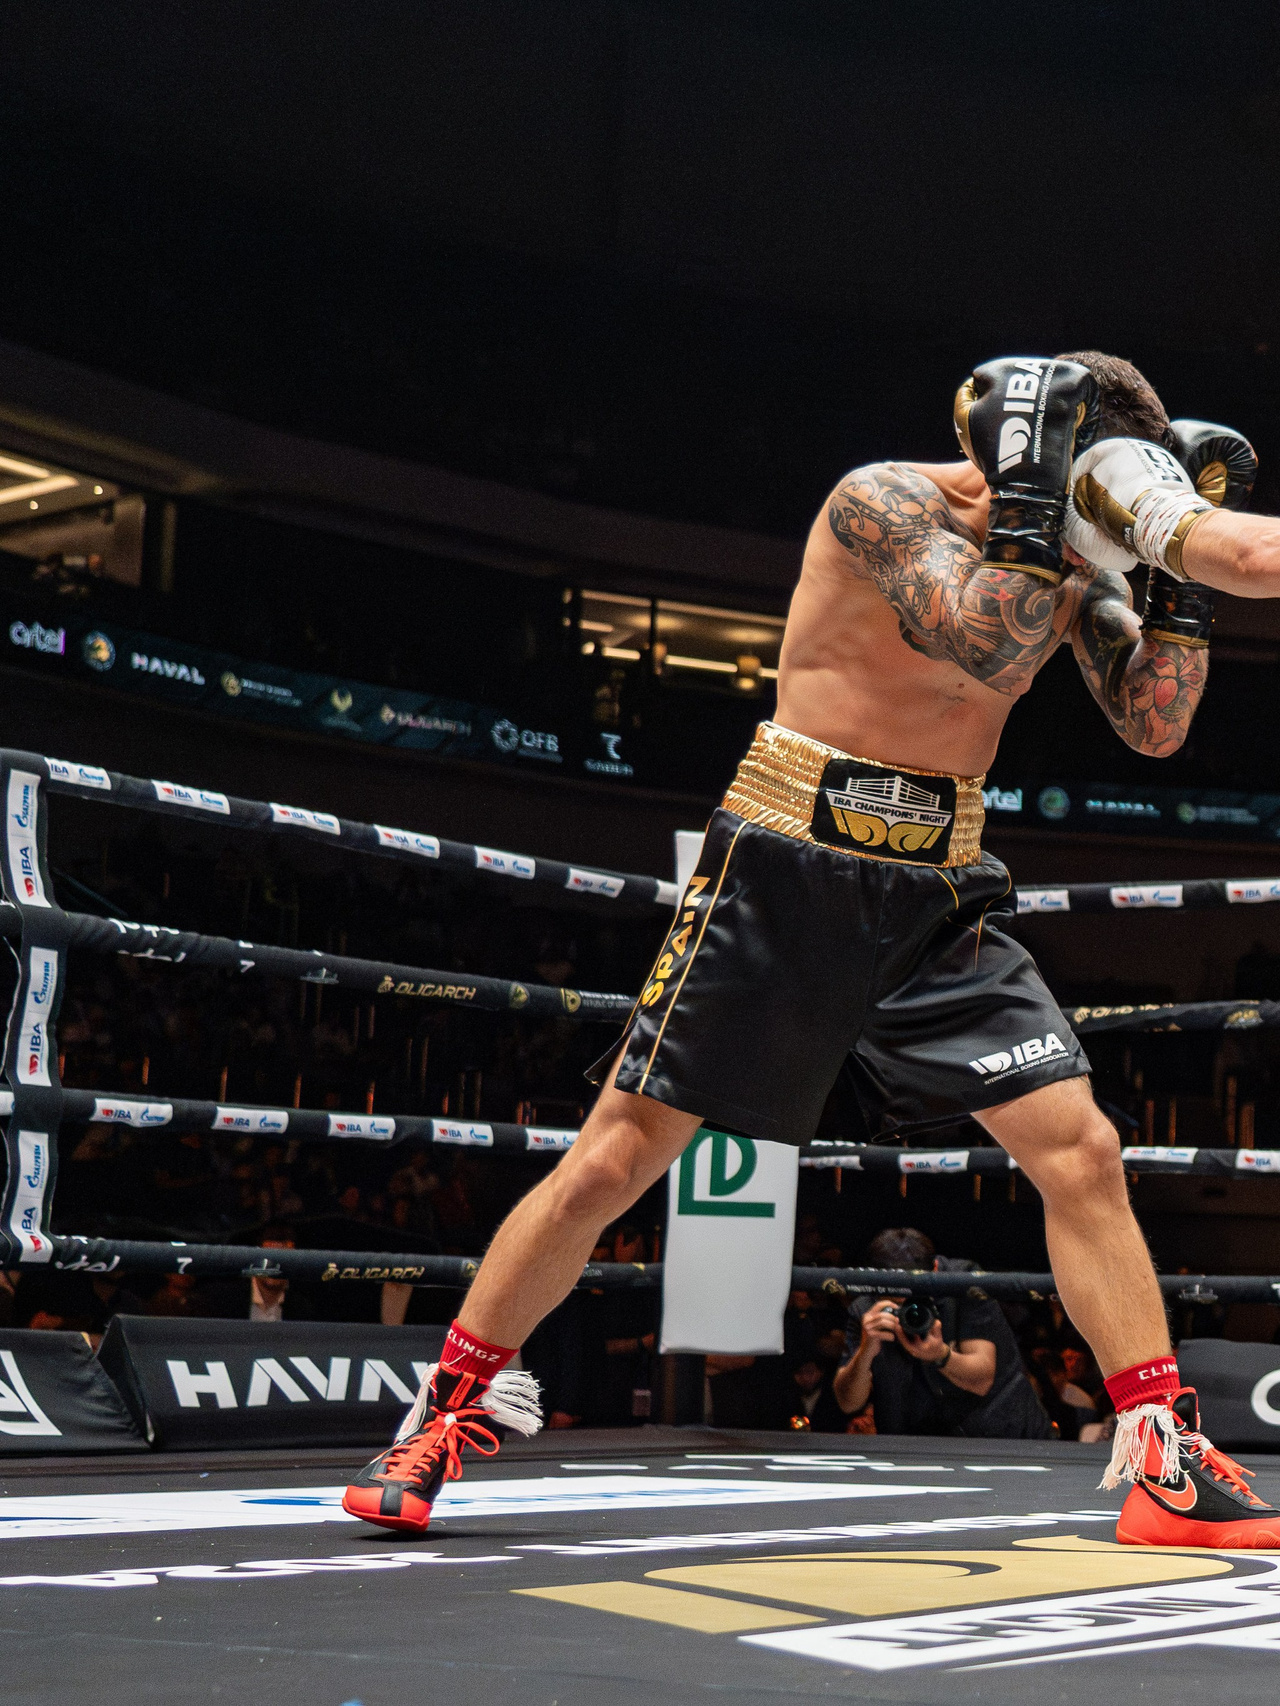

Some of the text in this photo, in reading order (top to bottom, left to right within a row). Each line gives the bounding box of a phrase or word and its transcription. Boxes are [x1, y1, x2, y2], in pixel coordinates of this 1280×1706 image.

[1003, 359, 1044, 414] IBA
[1038, 385, 1050, 411] BOXING
[1033, 412, 1045, 464] INTERNATIONAL
[131, 652, 206, 686] HAVAL
[833, 796, 947, 825] IBA CHAMPIONS' NIGHT
[19, 846, 33, 876] IBA
[640, 875, 711, 1008] SPAIN
[394, 982, 477, 1001] OLIGARCH
[29, 1022, 42, 1053] IBA
[1012, 1032, 1067, 1066] IBA
[113, 1109, 132, 1121] IBA
[20, 1206, 36, 1236] IBA
[447, 1328, 501, 1363] CLINGZ
[1138, 1363, 1179, 1381] CLIN
